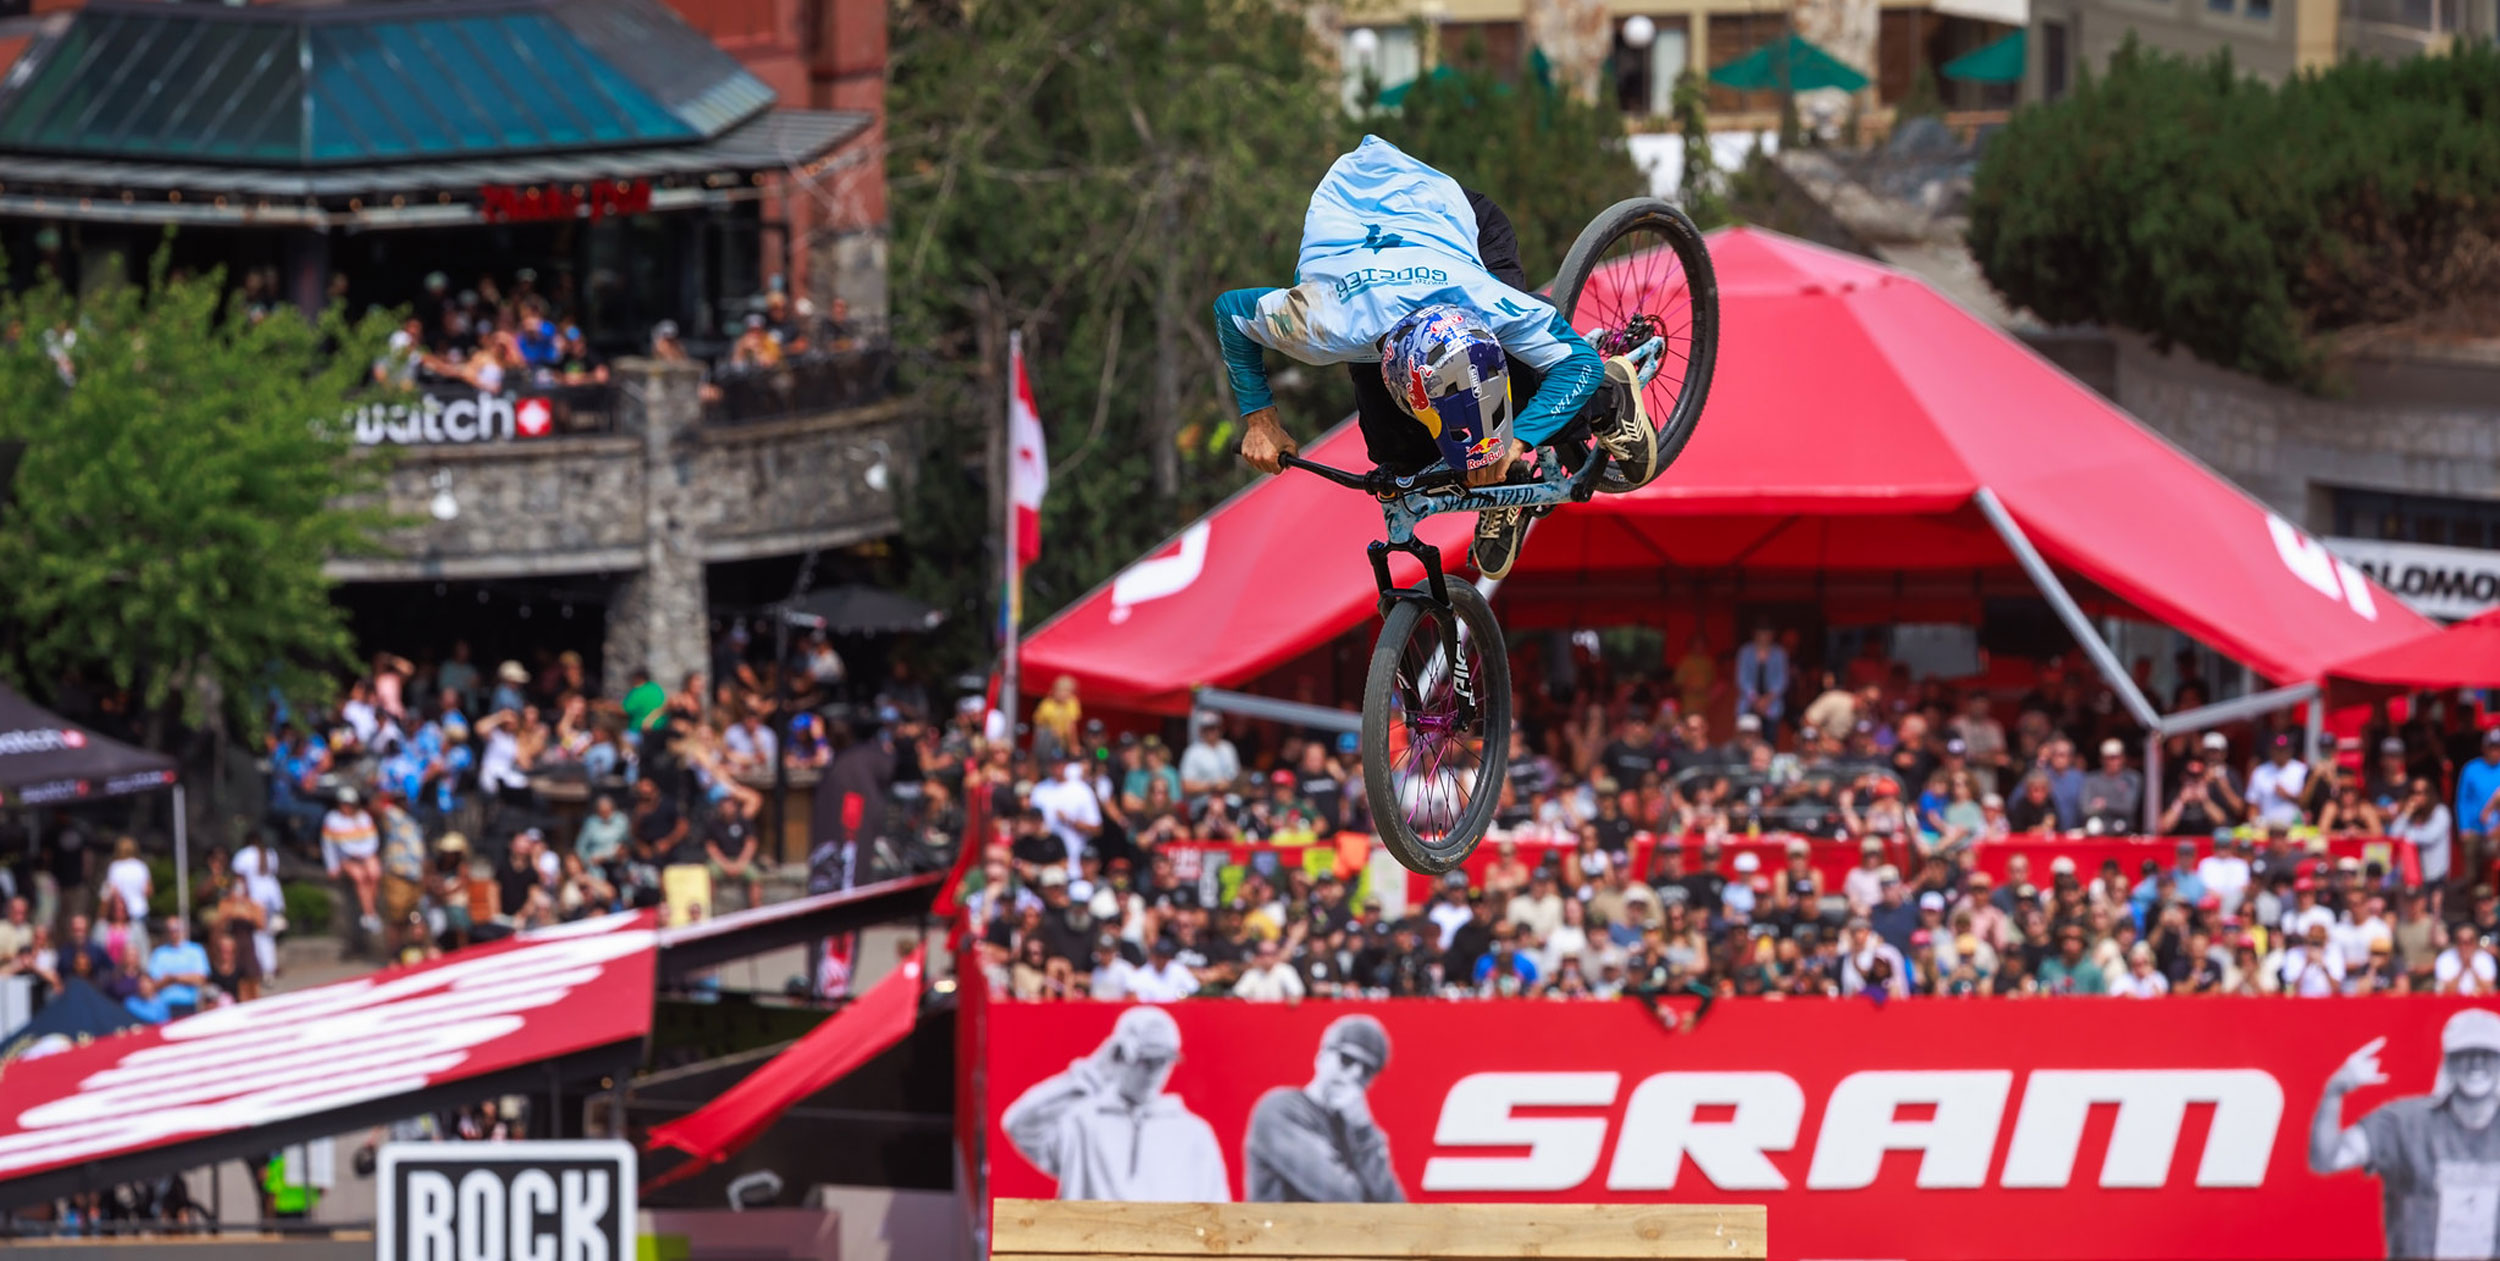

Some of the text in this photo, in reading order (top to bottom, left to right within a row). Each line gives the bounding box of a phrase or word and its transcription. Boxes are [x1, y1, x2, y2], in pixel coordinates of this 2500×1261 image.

[1467, 445, 1505, 470] Red Bull
[1421, 1068, 2284, 1191] SRAM
[407, 1168, 611, 1261] ROCK
